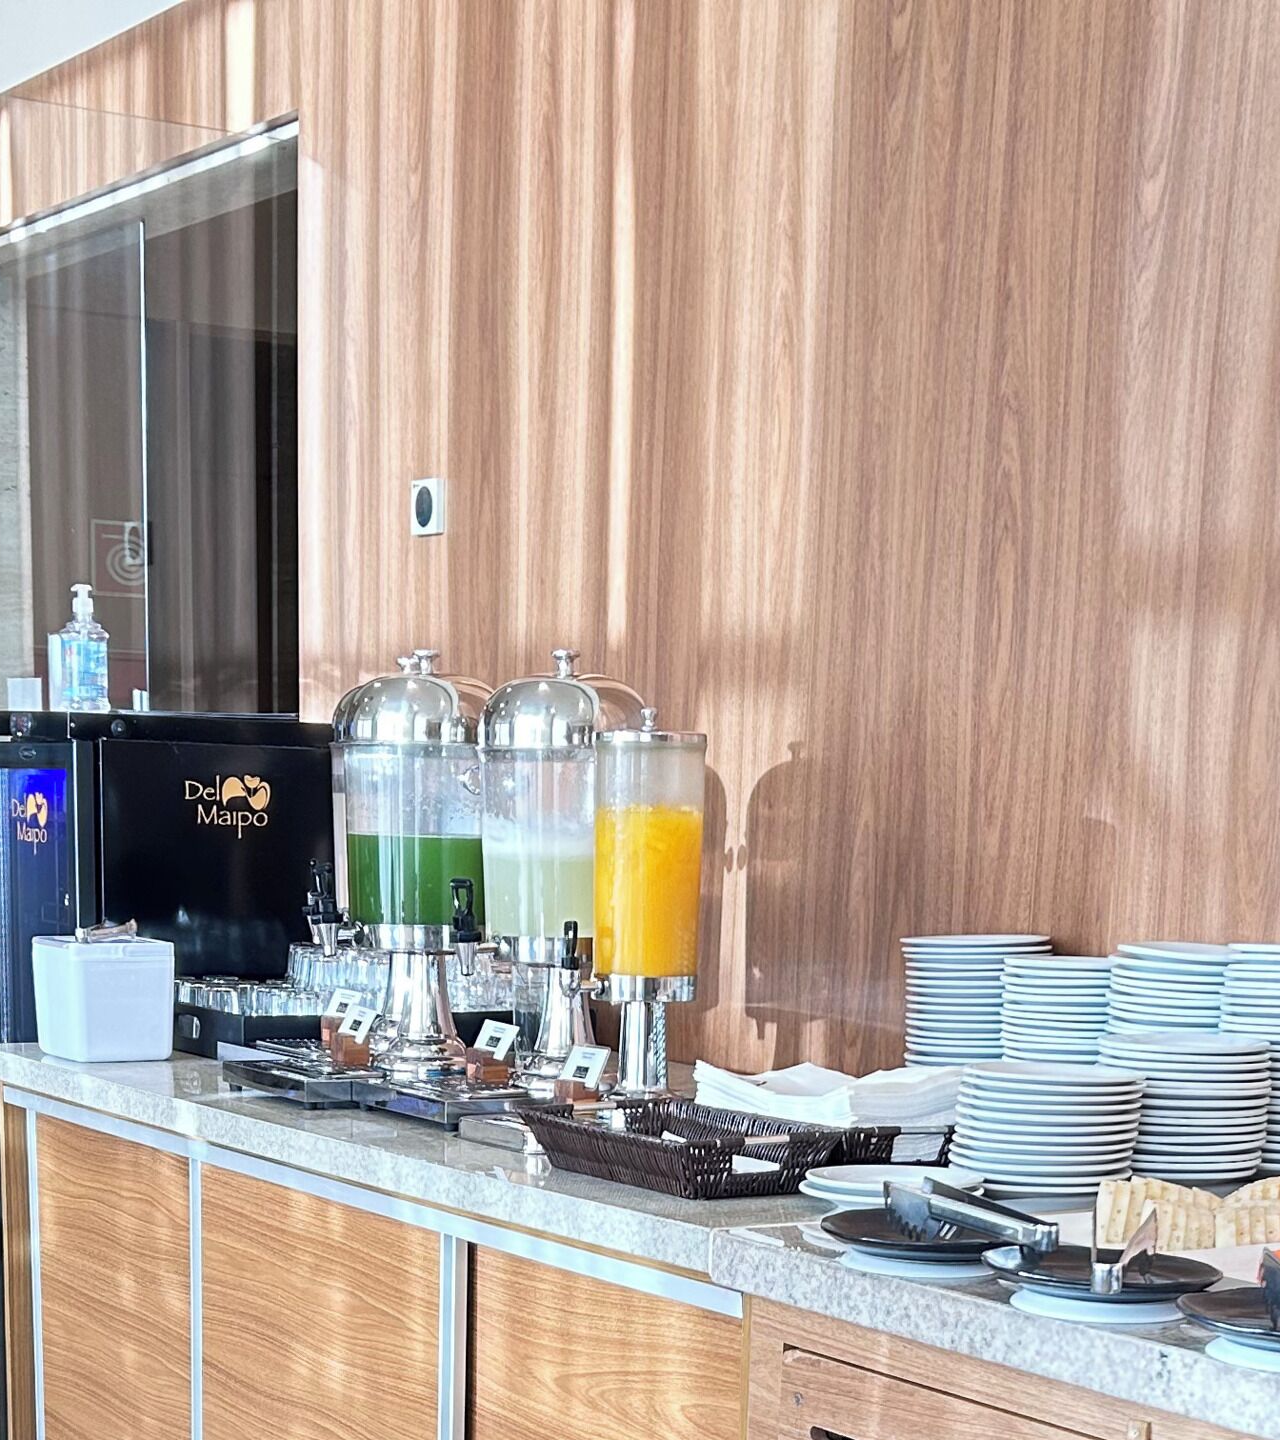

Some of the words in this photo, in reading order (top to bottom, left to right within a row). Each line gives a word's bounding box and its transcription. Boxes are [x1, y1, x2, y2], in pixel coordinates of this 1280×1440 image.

[184, 774, 221, 801] Del
[11, 792, 27, 818] Del
[197, 804, 269, 839] Maipo
[16, 821, 48, 856] Maipo
